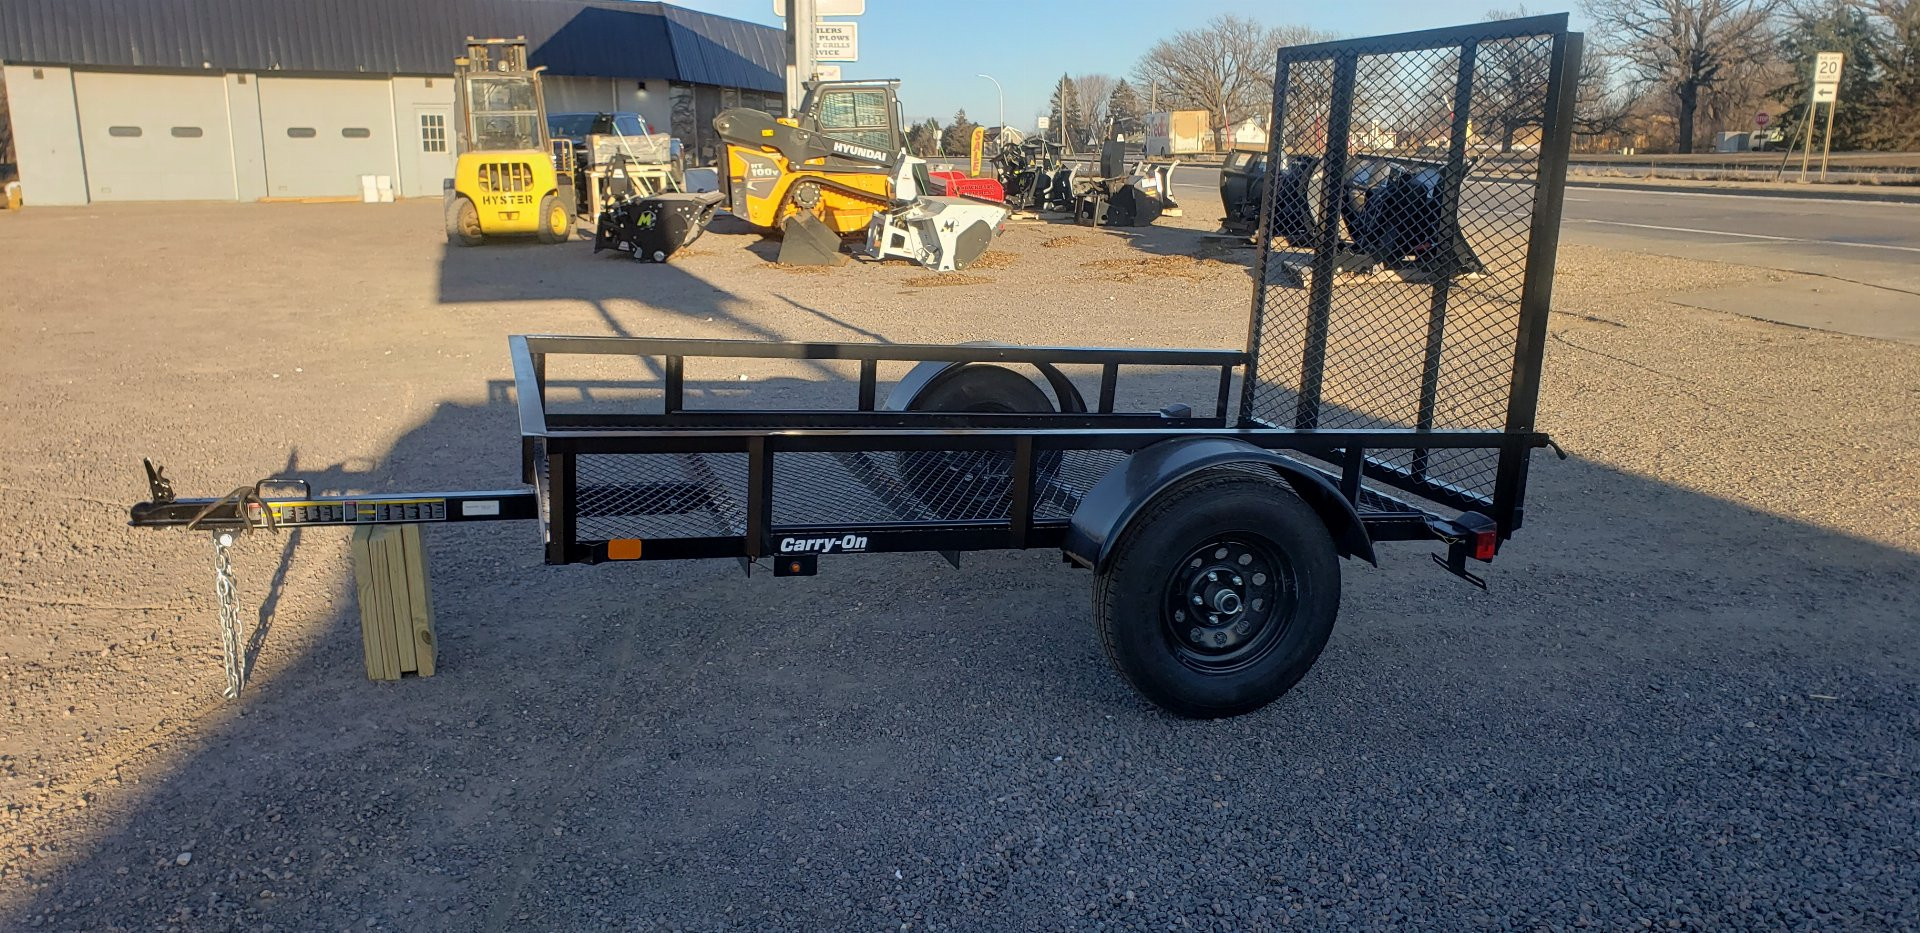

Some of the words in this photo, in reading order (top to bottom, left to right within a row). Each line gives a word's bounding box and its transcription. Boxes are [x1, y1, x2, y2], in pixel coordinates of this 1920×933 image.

[1819, 61, 1837, 74] 20
[833, 141, 887, 161] HYUNDAI
[973, 130, 983, 172] SALE
[482, 194, 533, 205] HYSTER
[780, 534, 868, 553] Carry-On
